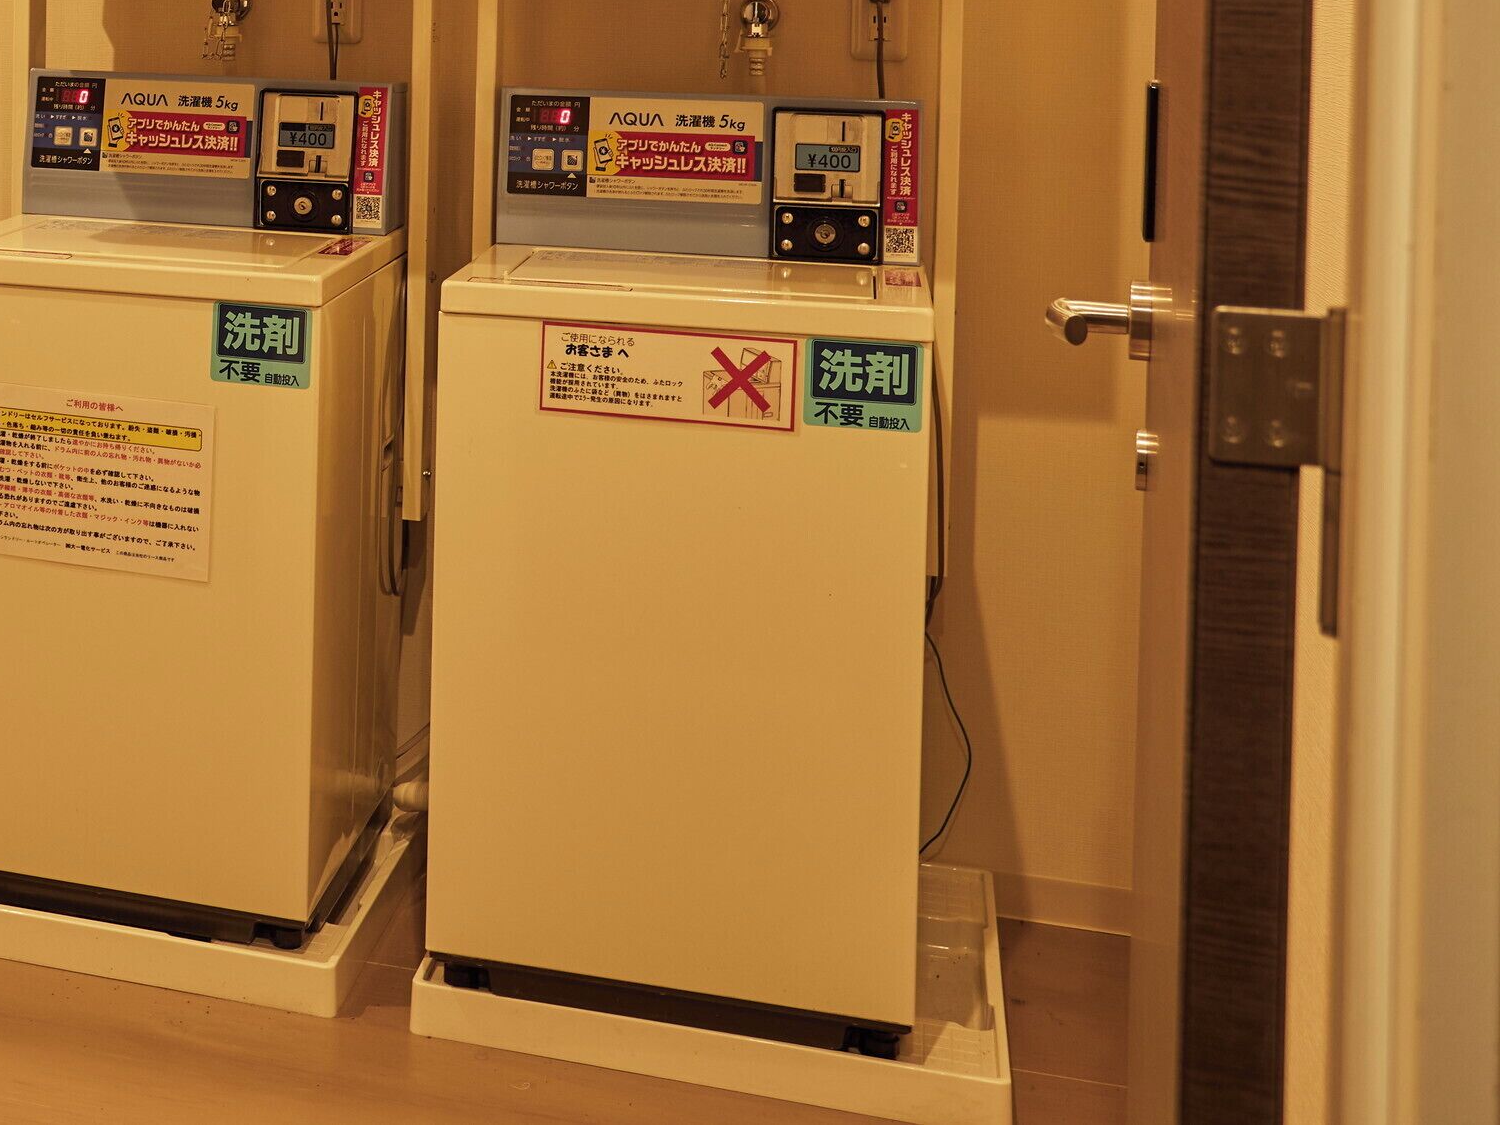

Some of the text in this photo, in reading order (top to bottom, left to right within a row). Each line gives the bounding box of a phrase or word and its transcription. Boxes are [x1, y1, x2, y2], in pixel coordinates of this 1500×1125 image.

[78, 90, 90, 104] 0
[120, 93, 239, 112] AQUA 洗濯機 5kg
[128, 118, 201, 132] アプリでかんたん
[559, 110, 572, 124] 0
[609, 112, 746, 131] AQUA 洗濯機 5kg
[289, 132, 328, 146] ¥400
[616, 138, 702, 153] アプリでかんたん
[807, 153, 852, 169] ¥400
[223, 311, 301, 356] 洗剤
[560, 331, 636, 347] ご使用になられる
[564, 343, 614, 359] お客さま
[219, 359, 300, 387] 不要 自動投入
[818, 348, 910, 396] 洗剤
[65, 398, 125, 413] ご利用の皆様へ
[814, 401, 910, 431] 不要 自動投入
